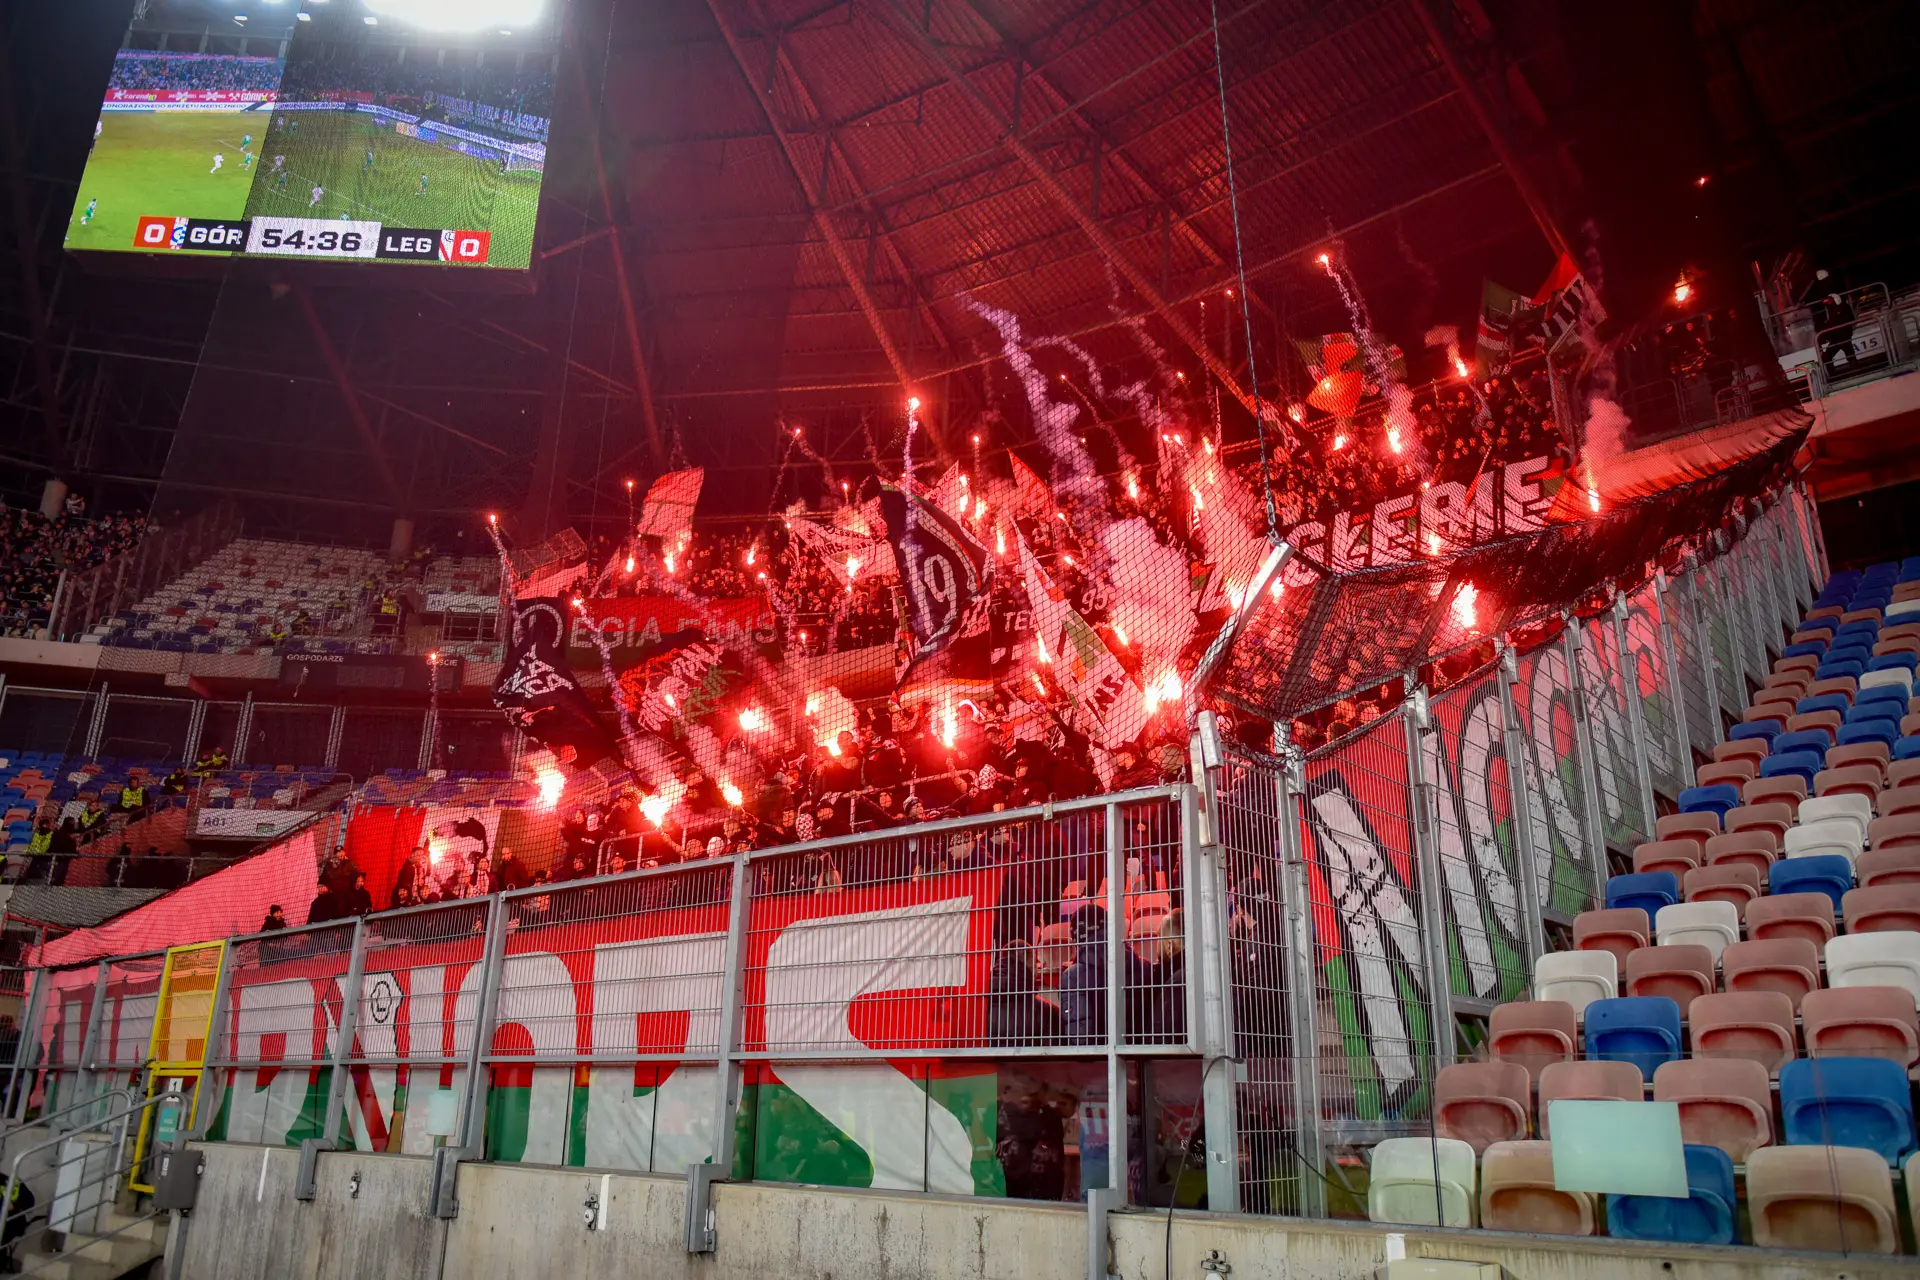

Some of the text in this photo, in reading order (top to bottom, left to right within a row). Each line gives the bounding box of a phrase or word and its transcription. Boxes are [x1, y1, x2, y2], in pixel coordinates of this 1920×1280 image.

[143, 223, 480, 257] 0 GÓR 54:36 LEG 0
[570, 616, 662, 648] EGIA
[426, 658, 458, 667] GŚCIE
[204, 816, 226, 827] A01
